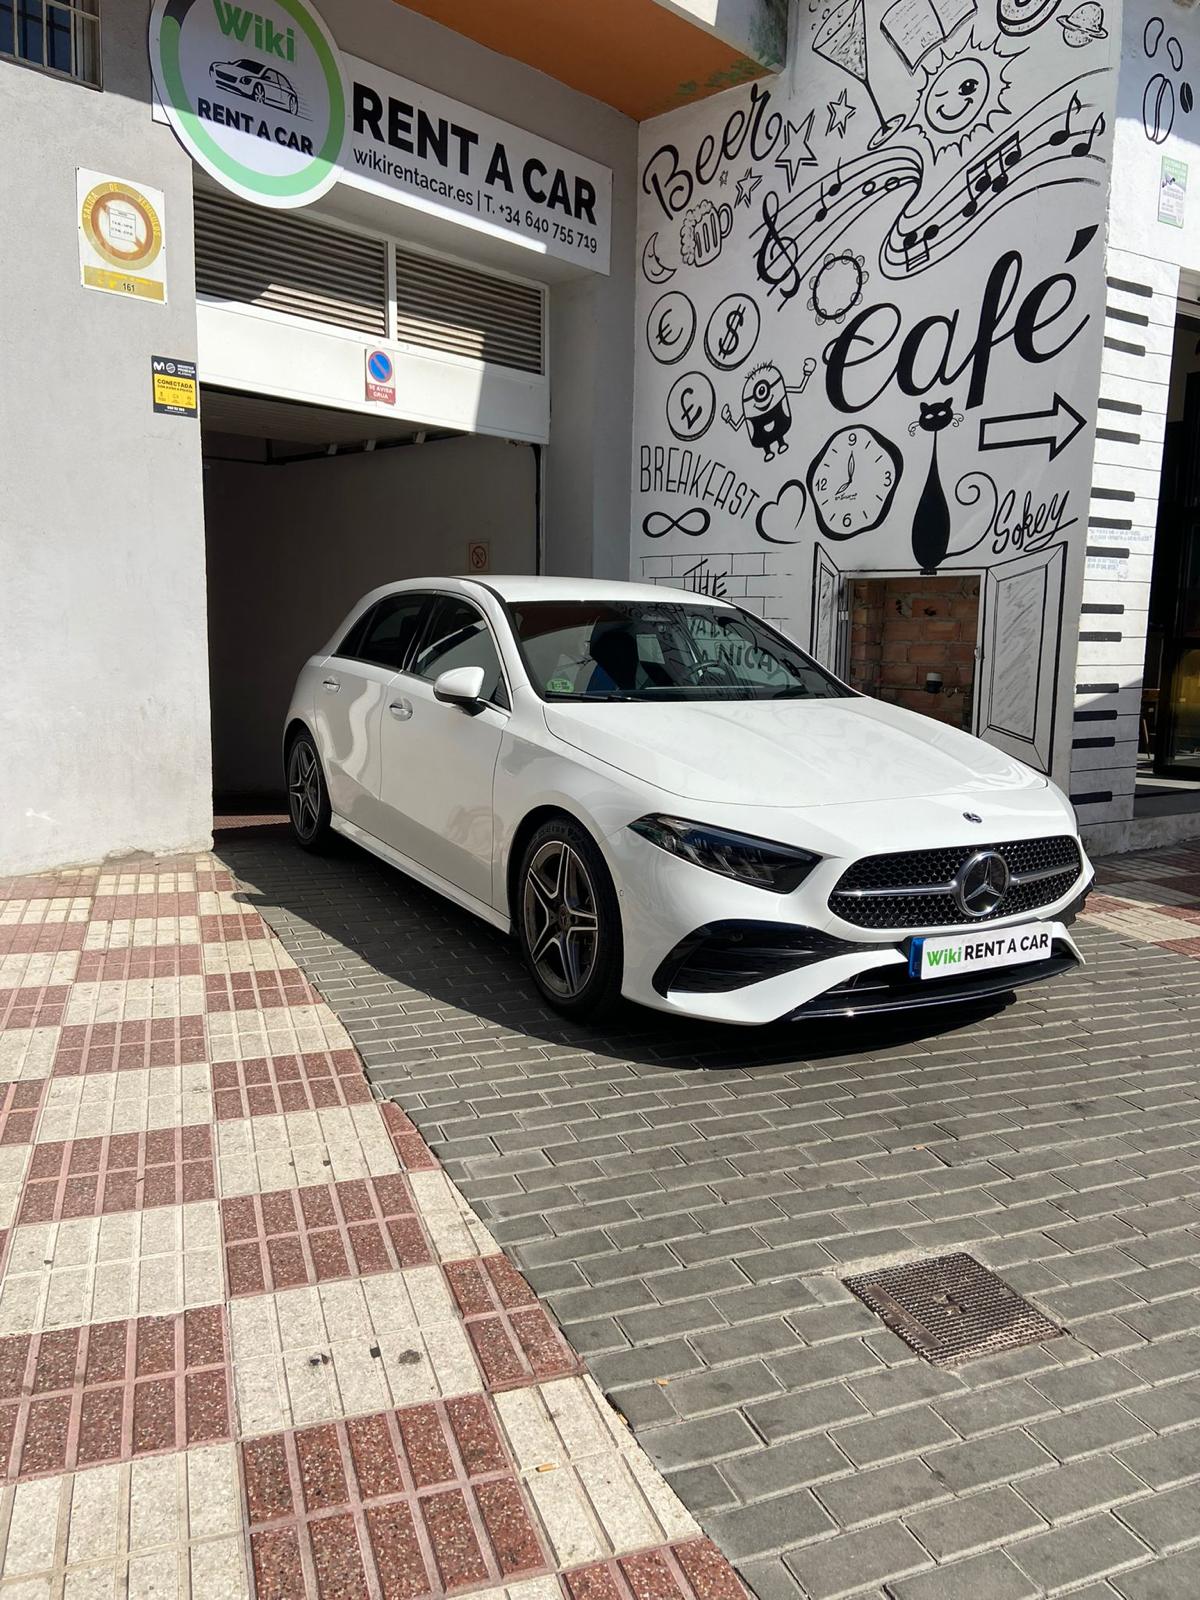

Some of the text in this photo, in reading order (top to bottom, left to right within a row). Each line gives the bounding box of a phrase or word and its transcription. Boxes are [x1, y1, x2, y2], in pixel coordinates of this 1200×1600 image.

[212, 0, 295, 62] Wiki
[197, 97, 314, 156] RENT A CAR
[353, 81, 597, 225] RENT A CAR
[642, 83, 782, 221] Beer
[353, 148, 473, 206] wikirentacar.es
[483, 193, 495, 214] T.
[499, 204, 521, 226] +34
[525, 210, 549, 233] 640
[552, 222, 574, 245] 755
[577, 231, 597, 254] 719
[122, 282, 136, 293] 161
[822, 224, 1100, 414] Café
[157, 378, 193, 390] CONECTADA
[848, 432, 857, 447] 9
[640, 445, 760, 520] BREAKFAST
[815, 478, 827, 492] 12
[883, 470, 892, 487] 3
[842, 512, 852, 528] 6
[683, 558, 728, 598] THE
[927, 933, 1049, 967] Wiki RENT A CAR
